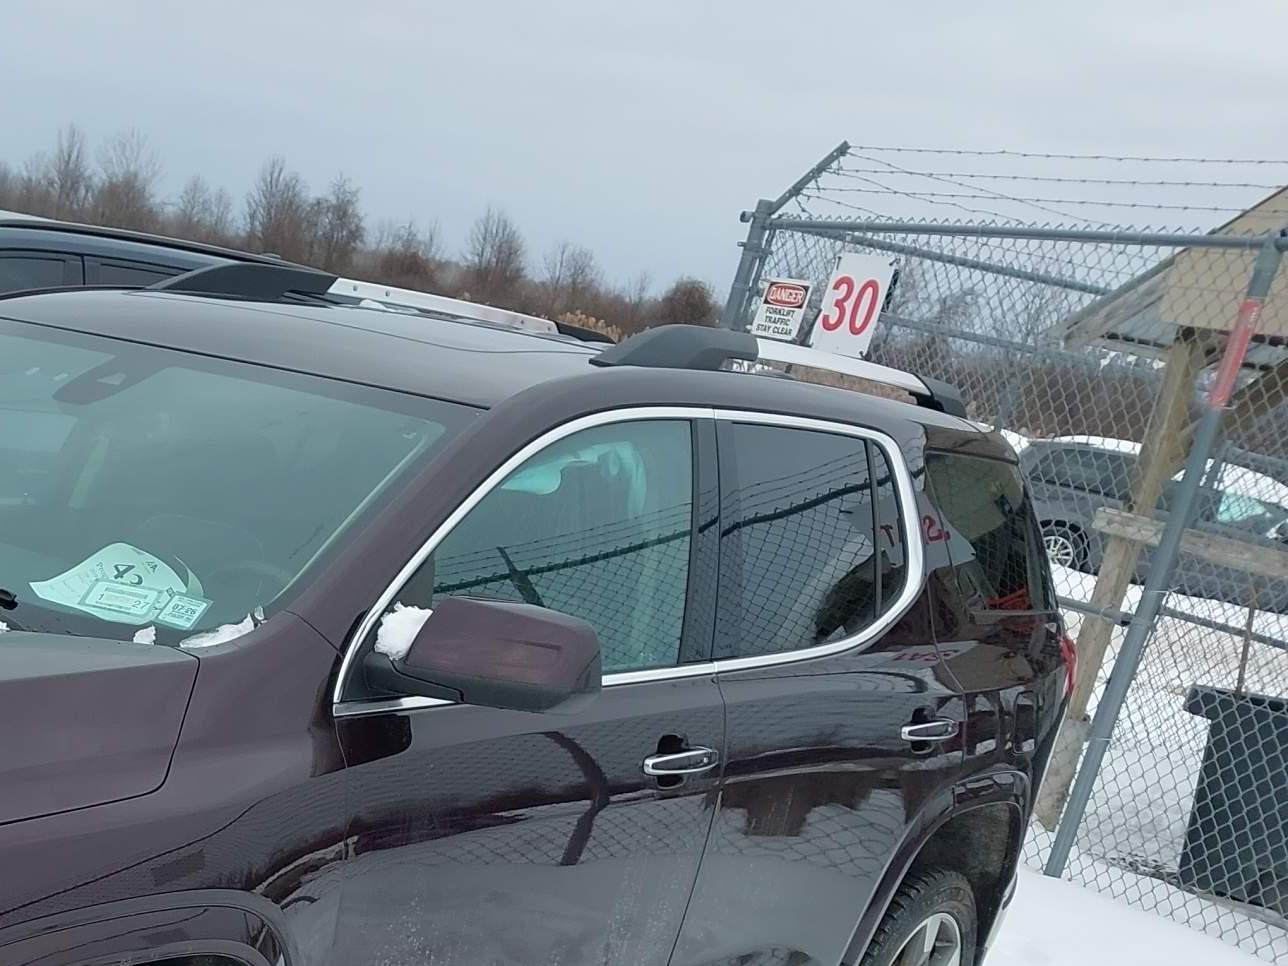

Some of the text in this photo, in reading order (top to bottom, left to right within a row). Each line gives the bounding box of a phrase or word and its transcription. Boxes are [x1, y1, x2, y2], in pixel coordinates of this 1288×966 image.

[770, 287, 803, 302] DANGER
[822, 275, 879, 335] 30
[766, 307, 795, 317] FORKLIFT
[765, 315, 791, 326] TRAFFIC
[756, 323, 792, 335] STAY CLEAR
